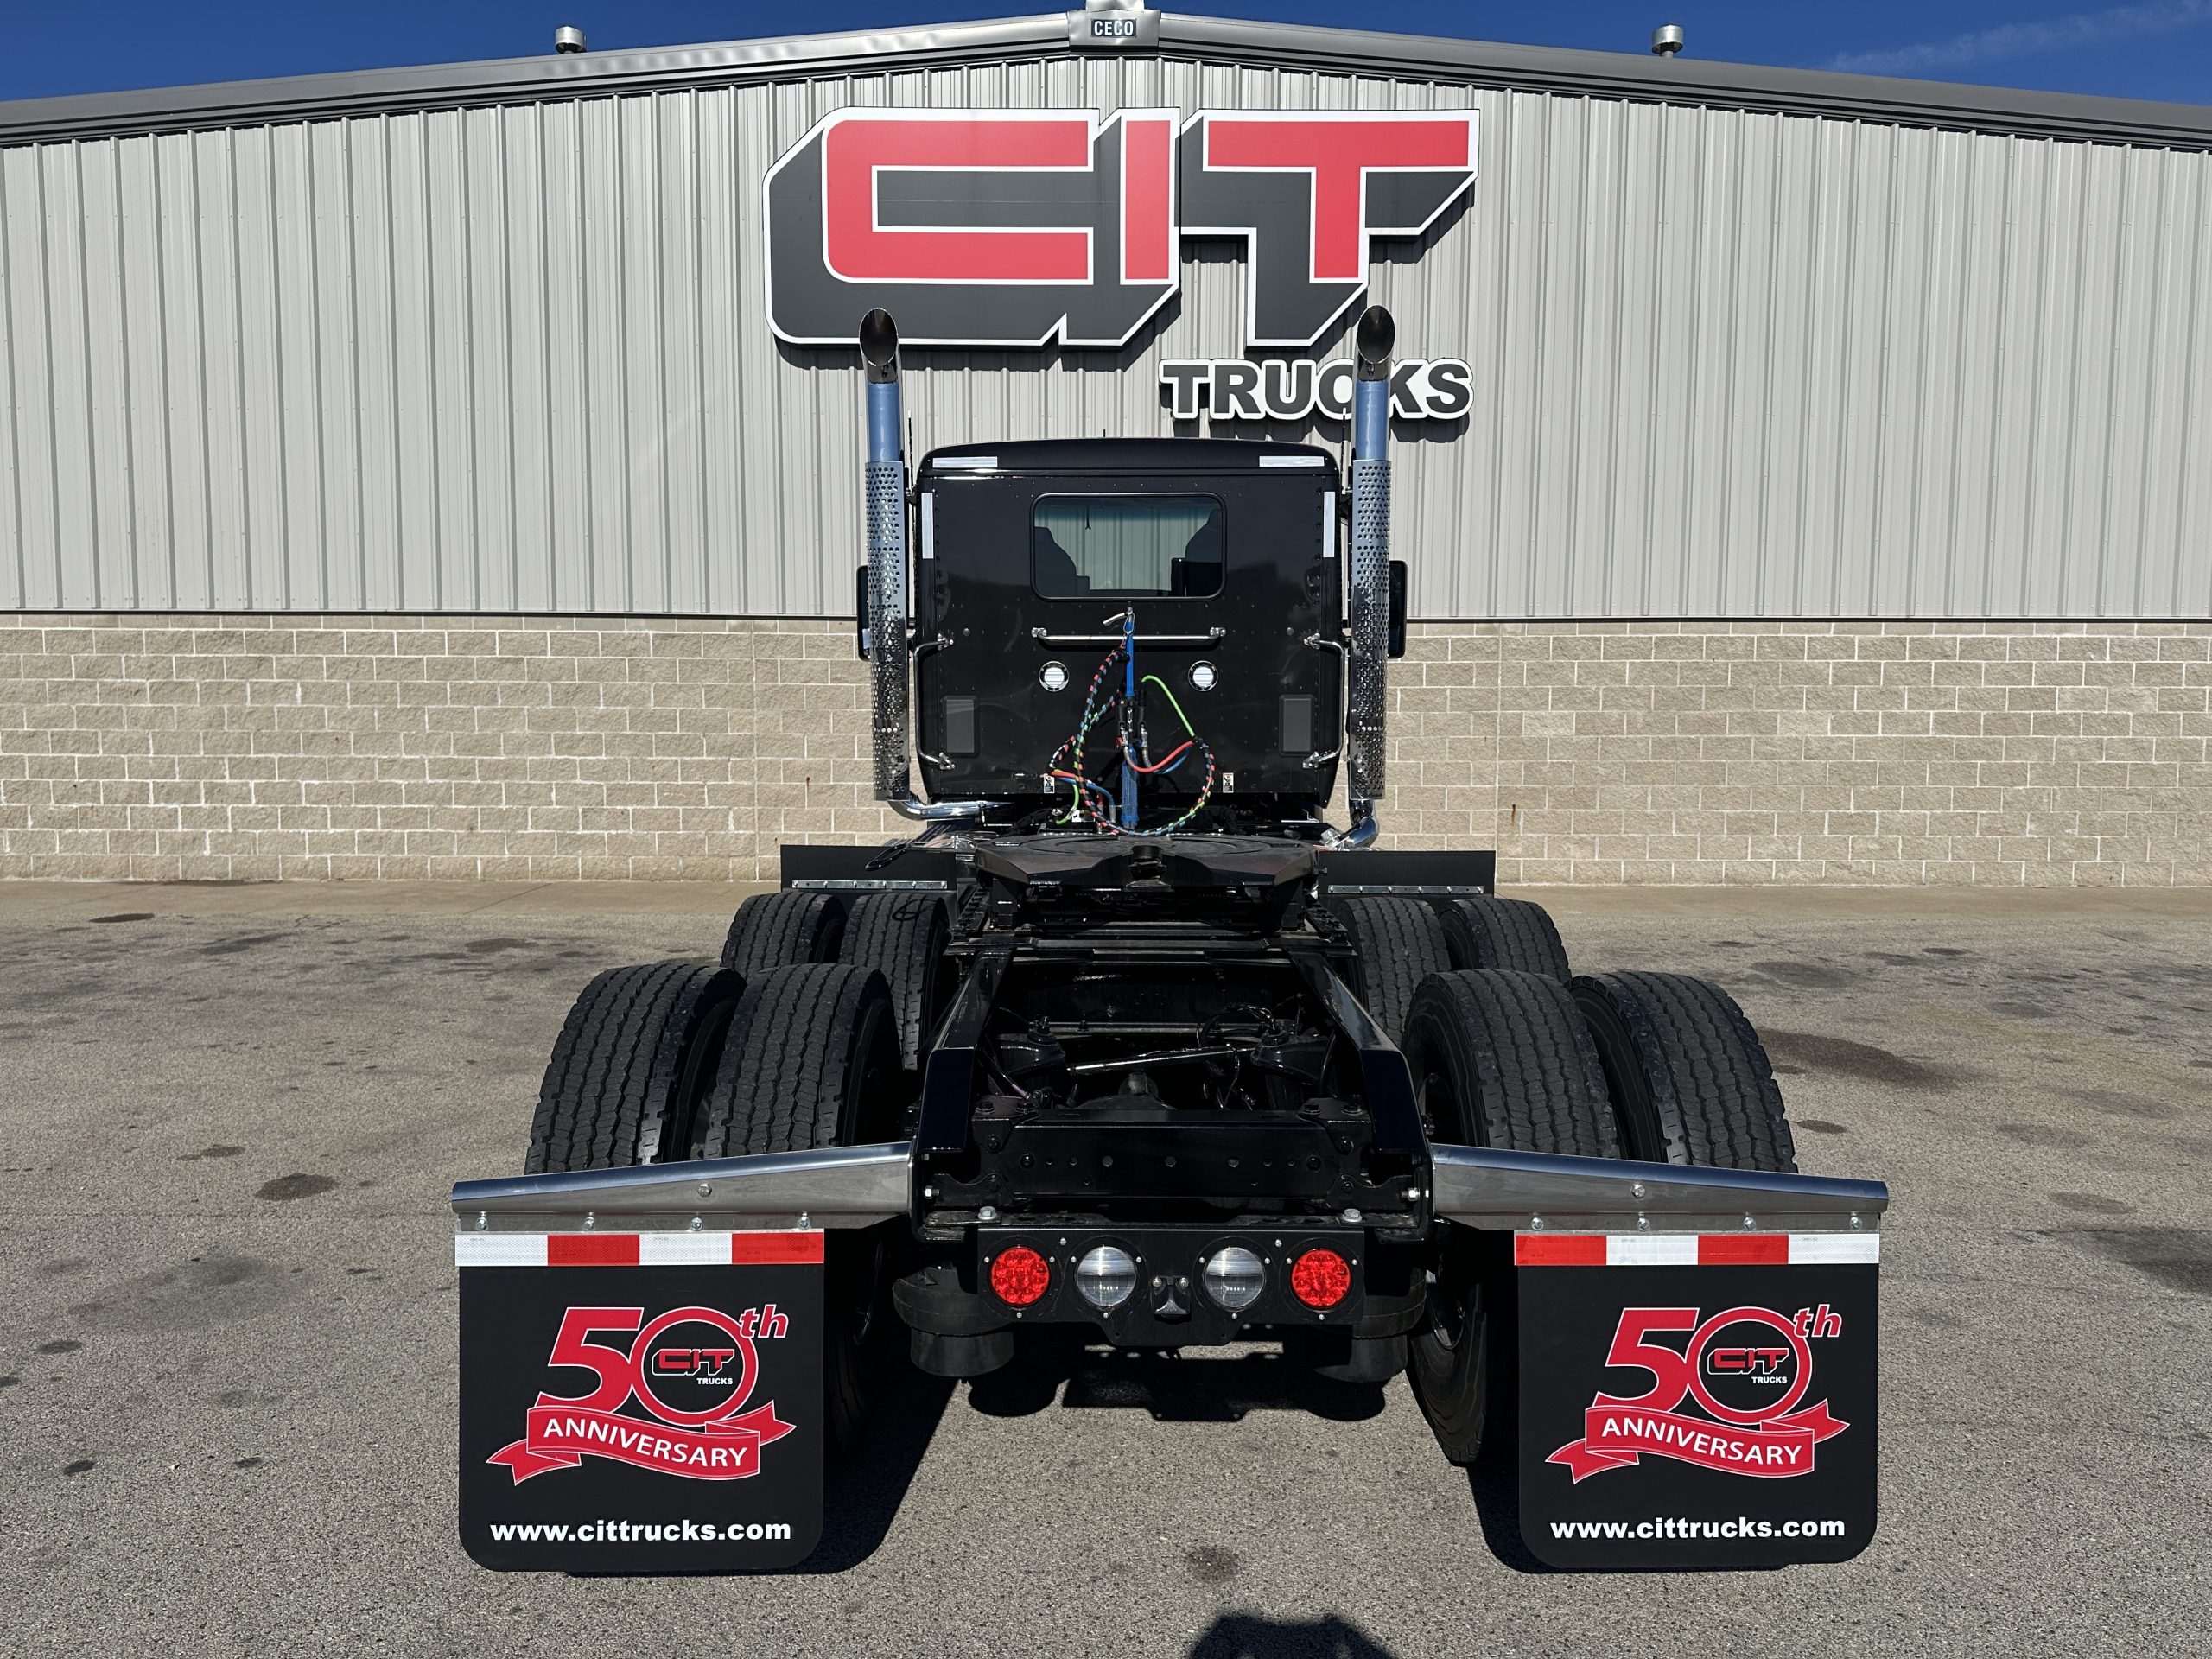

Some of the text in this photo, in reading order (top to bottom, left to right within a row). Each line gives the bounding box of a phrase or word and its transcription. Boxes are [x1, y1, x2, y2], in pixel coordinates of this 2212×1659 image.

[1094, 20, 1134, 35] CECO
[763, 107, 1480, 347] CIT
[1159, 359, 1474, 420] TRUCKS
[652, 1348, 735, 1376] CIT
[1707, 1347, 1789, 1375] CIT
[543, 1417, 747, 1468] ANNIVERSARY
[1601, 1417, 1802, 1465] ANNIVERSARY
[490, 1518, 791, 1541] www.cittrucks.com
[1549, 1516, 1846, 1539] www.cittrucks.com
